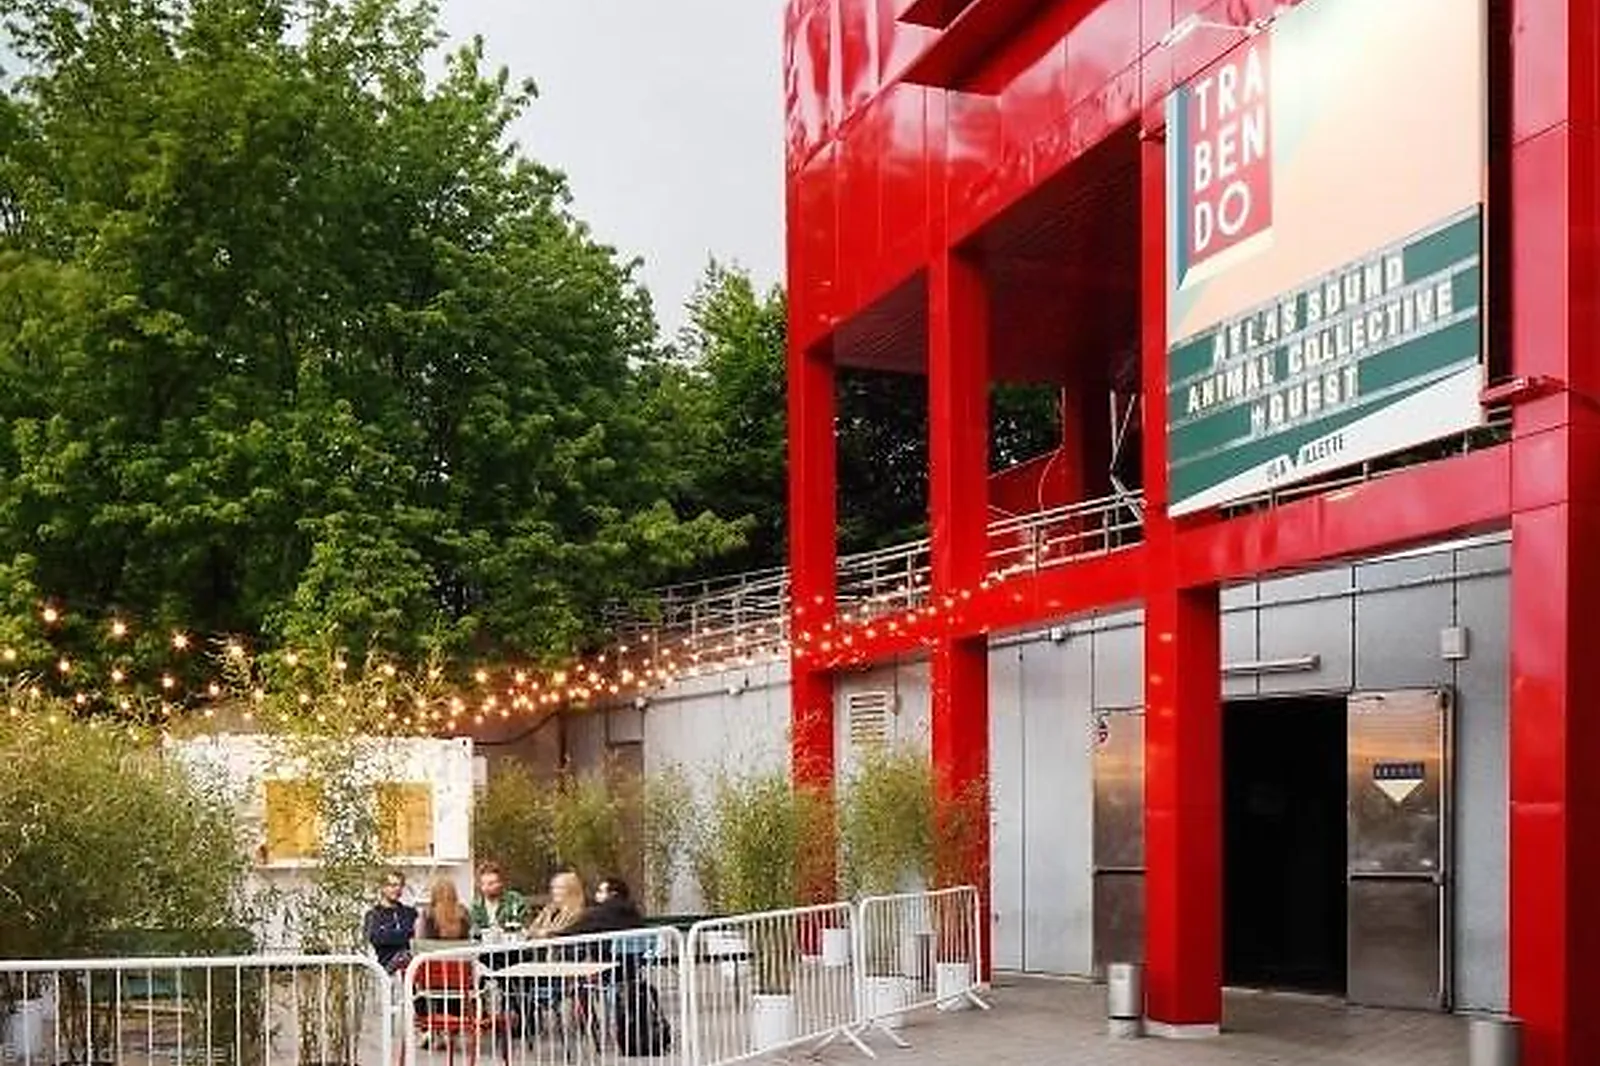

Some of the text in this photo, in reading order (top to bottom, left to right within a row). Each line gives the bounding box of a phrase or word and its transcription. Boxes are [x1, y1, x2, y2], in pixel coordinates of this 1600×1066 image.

[1195, 46, 1264, 132] TRA
[1194, 104, 1265, 194] BEN
[1194, 180, 1250, 252] DO
[1308, 256, 1403, 321] SOUND
[1187, 283, 1452, 414] ANIMAL COLLECTIVE
